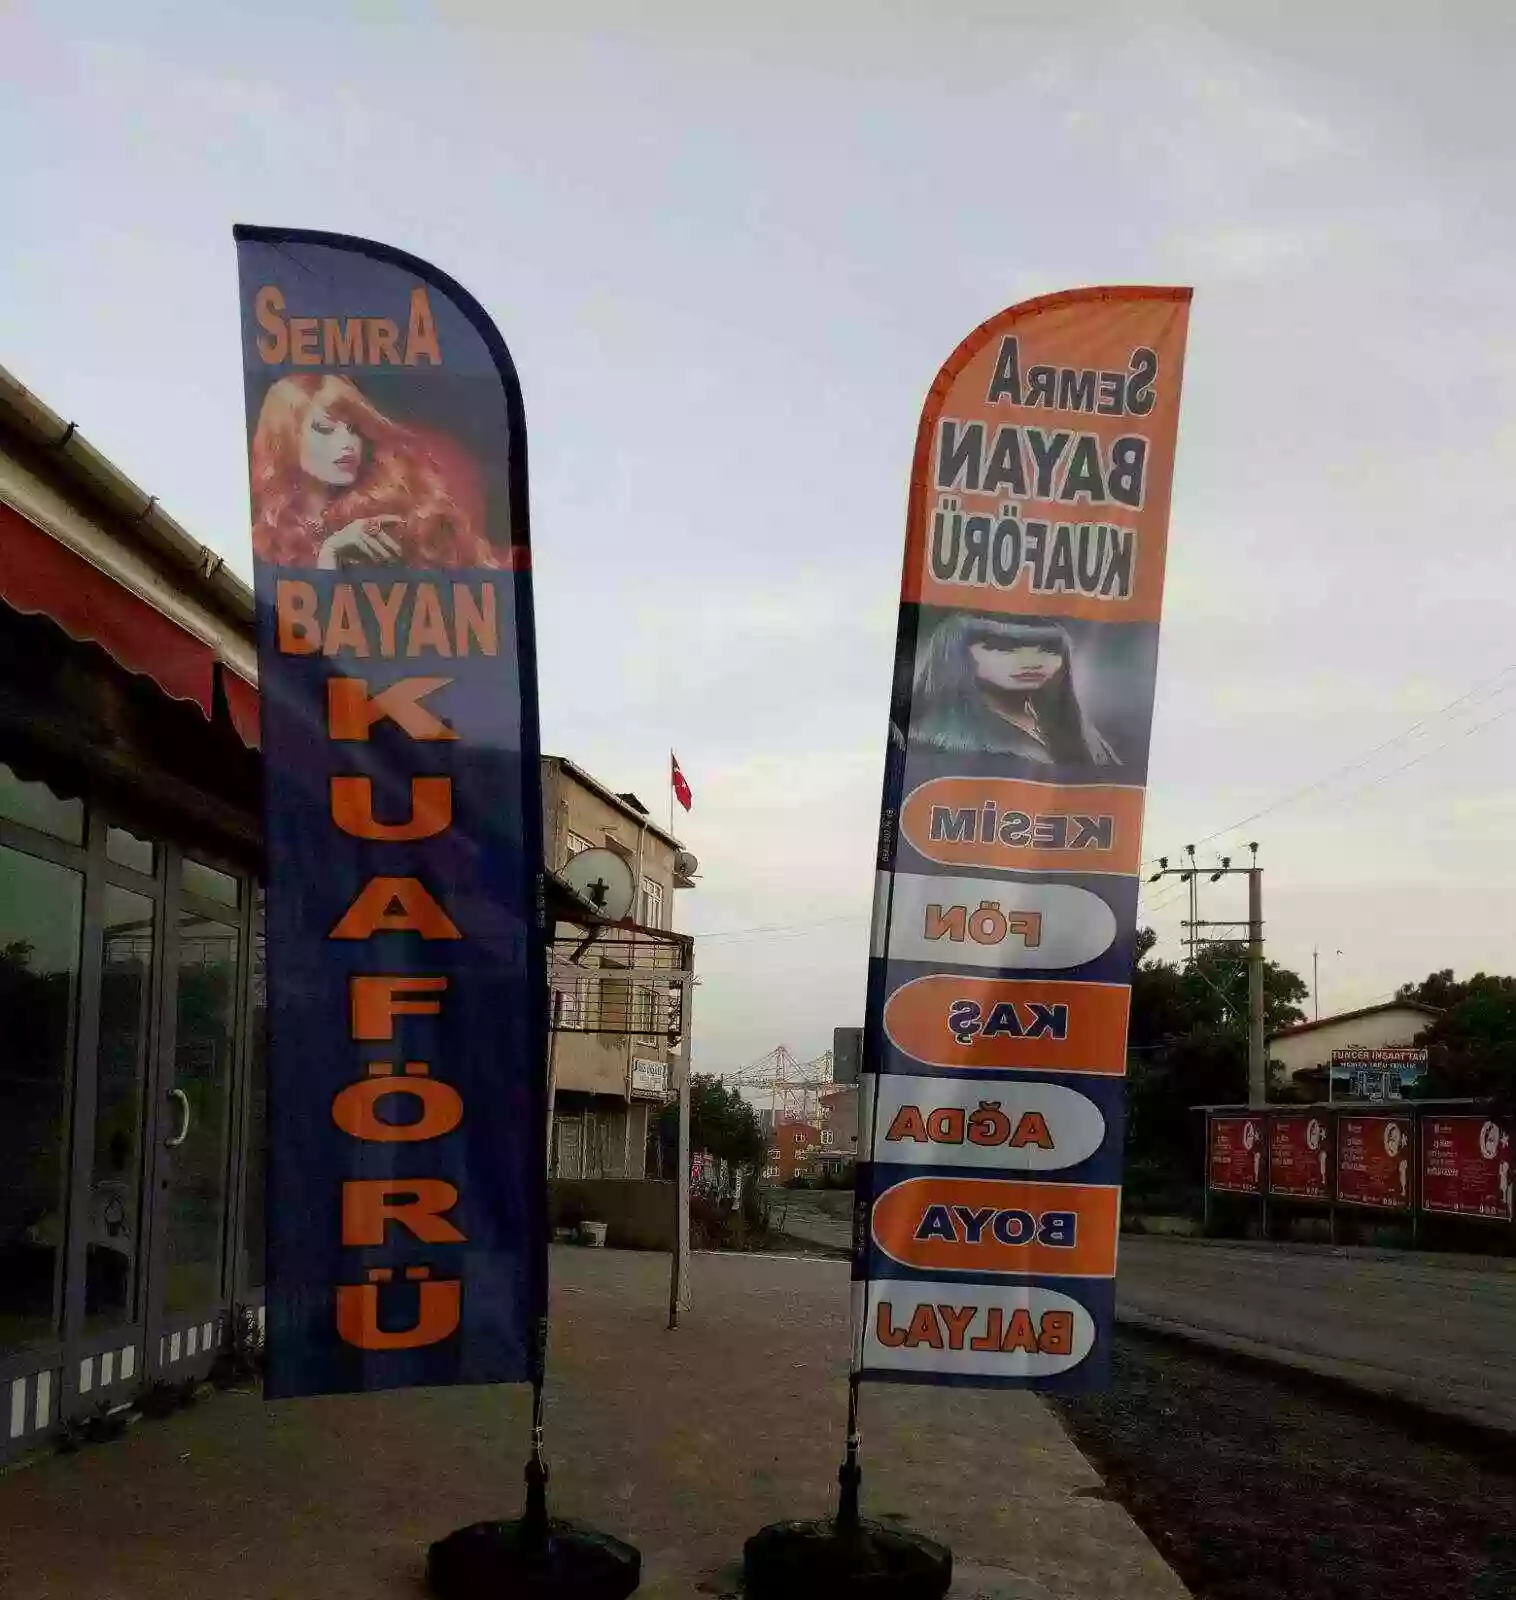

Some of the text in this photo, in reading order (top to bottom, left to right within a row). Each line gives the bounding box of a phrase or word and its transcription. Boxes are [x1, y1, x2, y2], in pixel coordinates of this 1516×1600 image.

[255, 285, 443, 366] SEMRA
[276, 580, 499, 657] BAYAN
[328, 677, 468, 1349] KUAFÖRÜ
